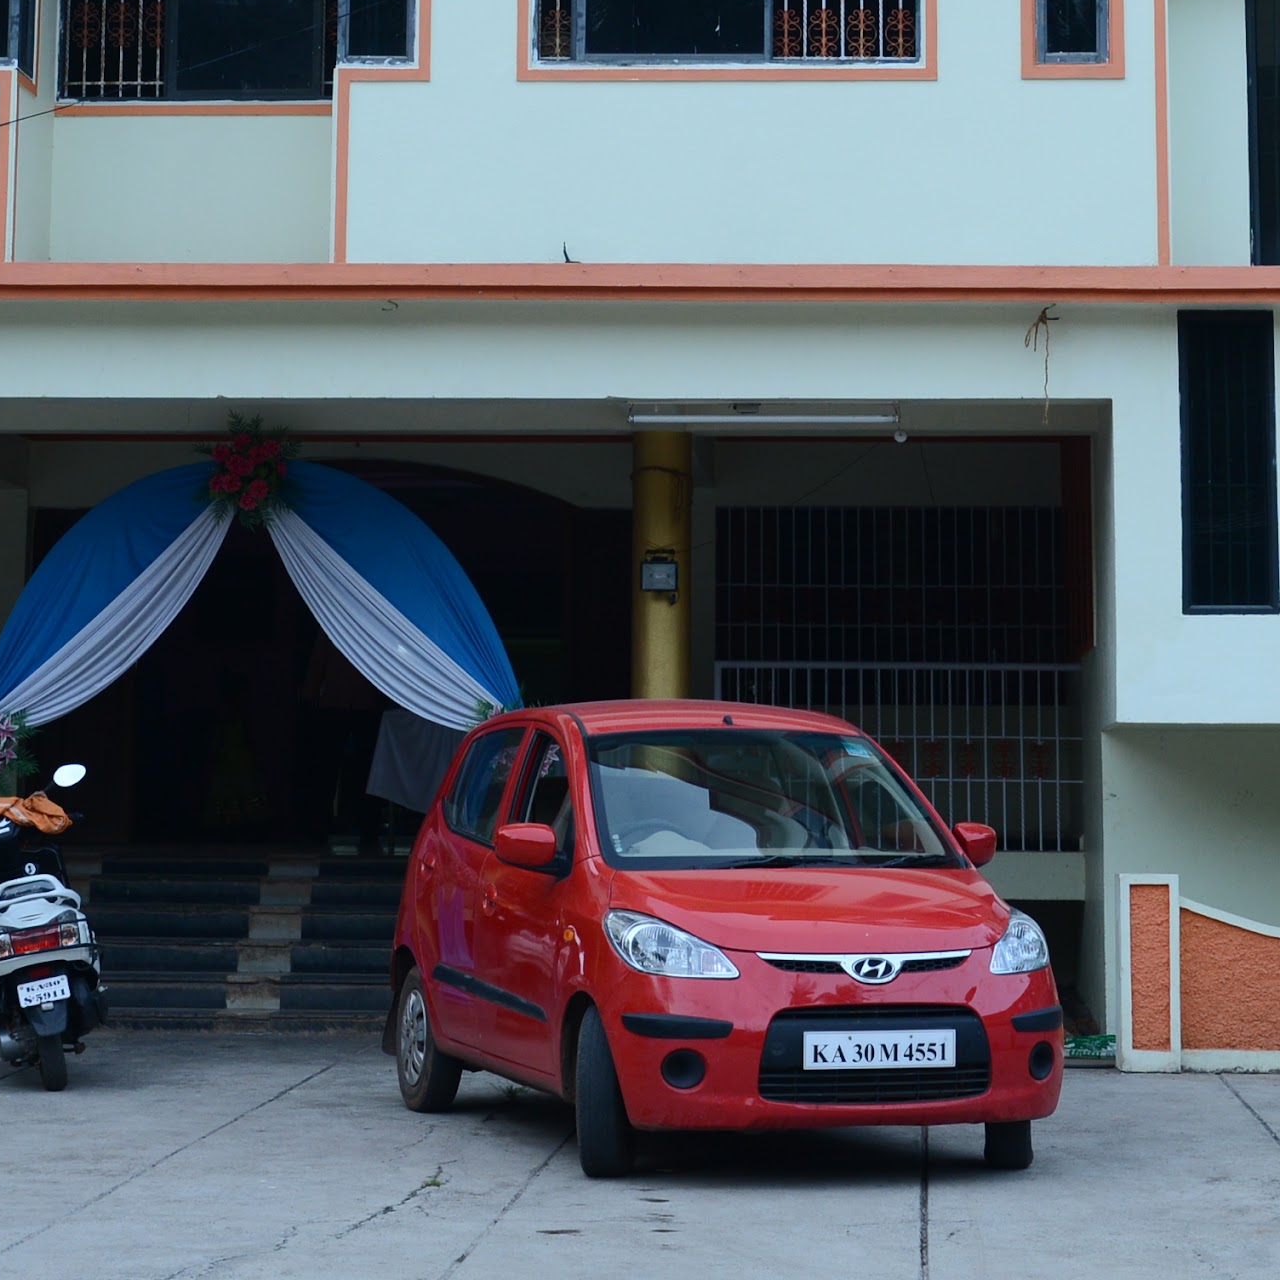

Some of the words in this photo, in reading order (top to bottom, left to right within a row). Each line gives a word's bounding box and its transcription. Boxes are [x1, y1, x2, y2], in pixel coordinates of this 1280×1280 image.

[852, 1044, 875, 1063] 30
[880, 1043, 898, 1062] M
[903, 1042, 946, 1061] 4551
